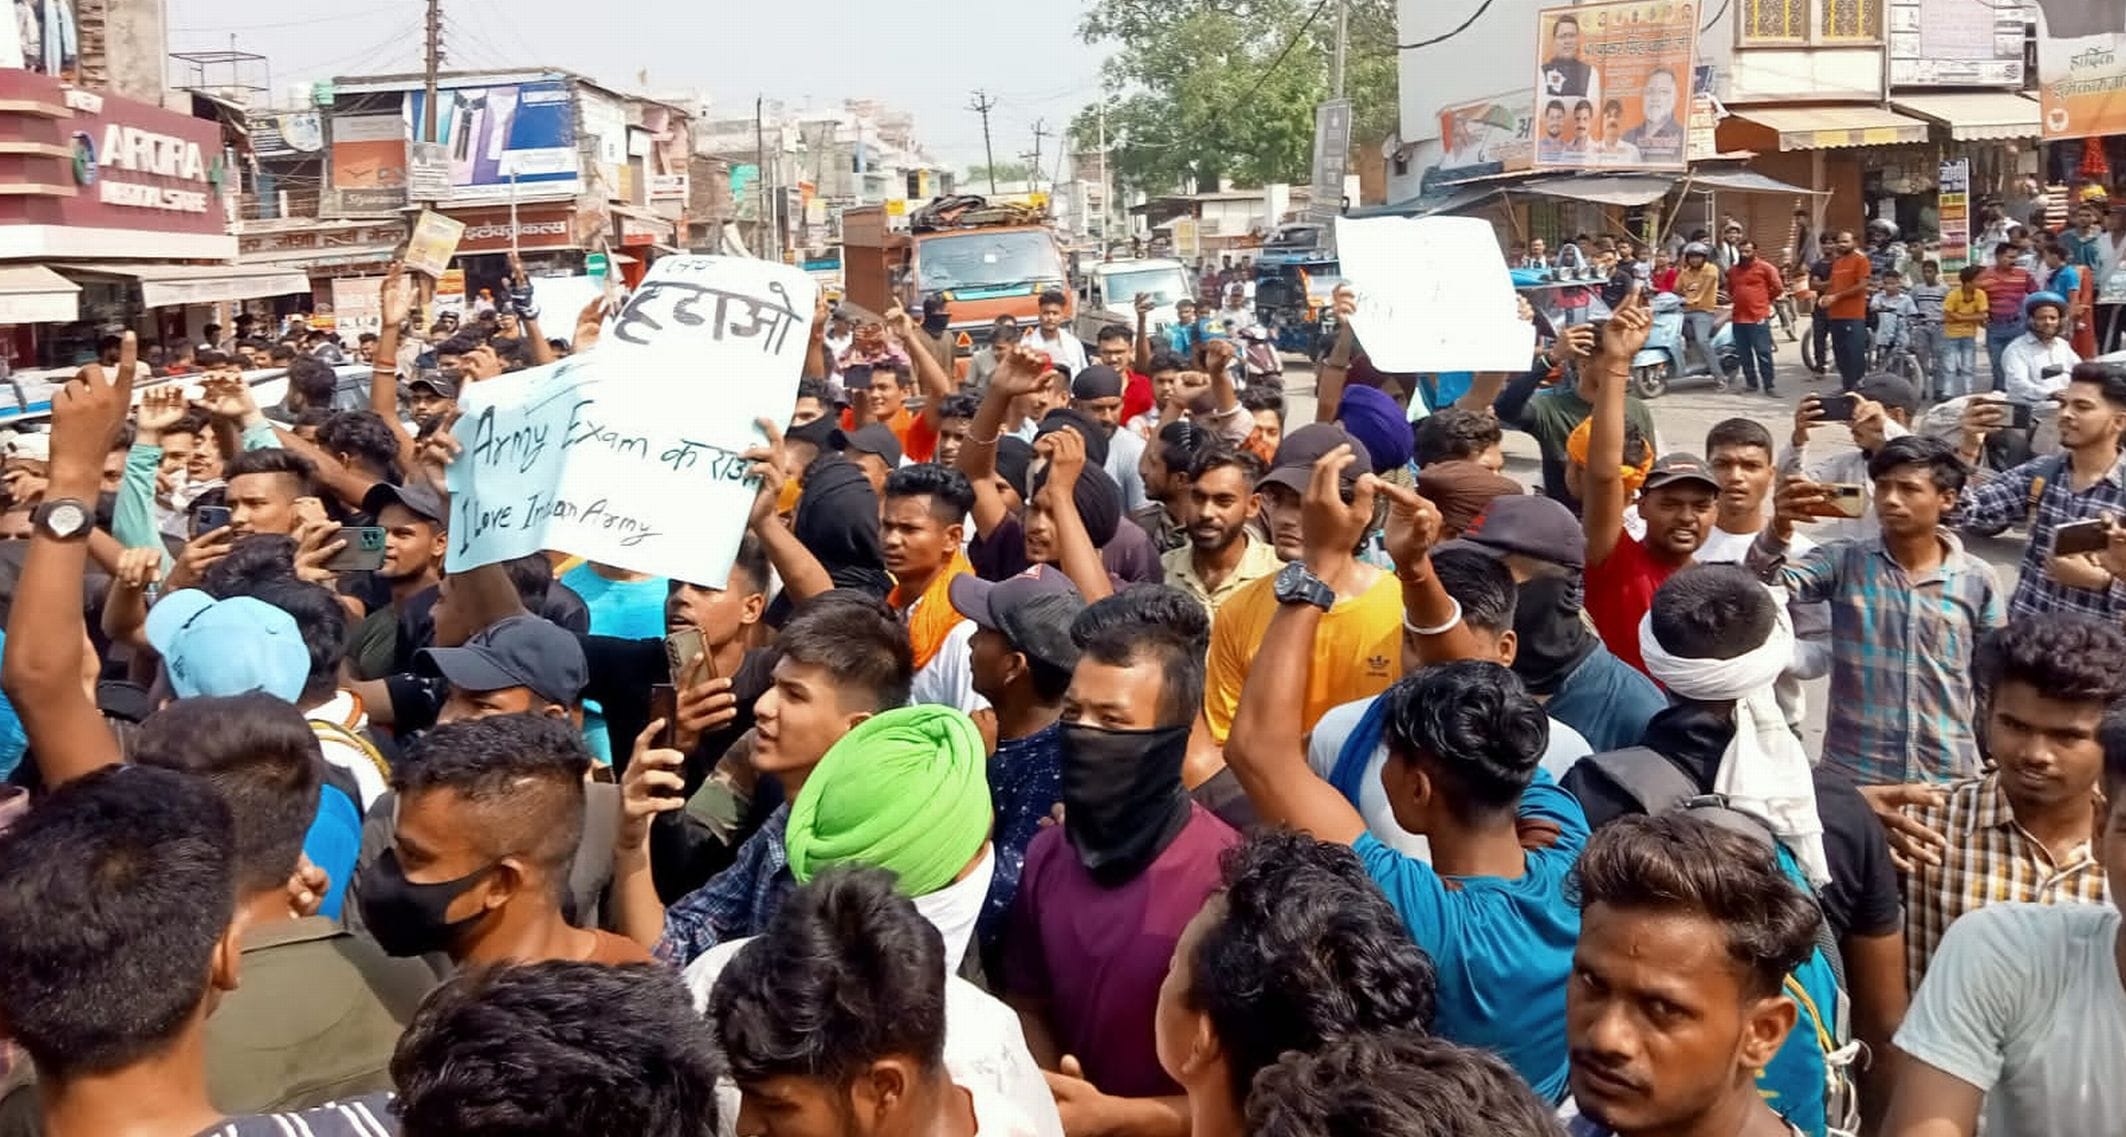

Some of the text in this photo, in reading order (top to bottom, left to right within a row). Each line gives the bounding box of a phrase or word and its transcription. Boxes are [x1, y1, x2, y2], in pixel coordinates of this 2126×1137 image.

[98, 123, 208, 183] ARORA
[614, 281, 803, 355] हटाओ
[473, 404, 549, 474] Army
[561, 399, 648, 460] Exam
[459, 497, 470, 557] I
[579, 499, 663, 547] Army
